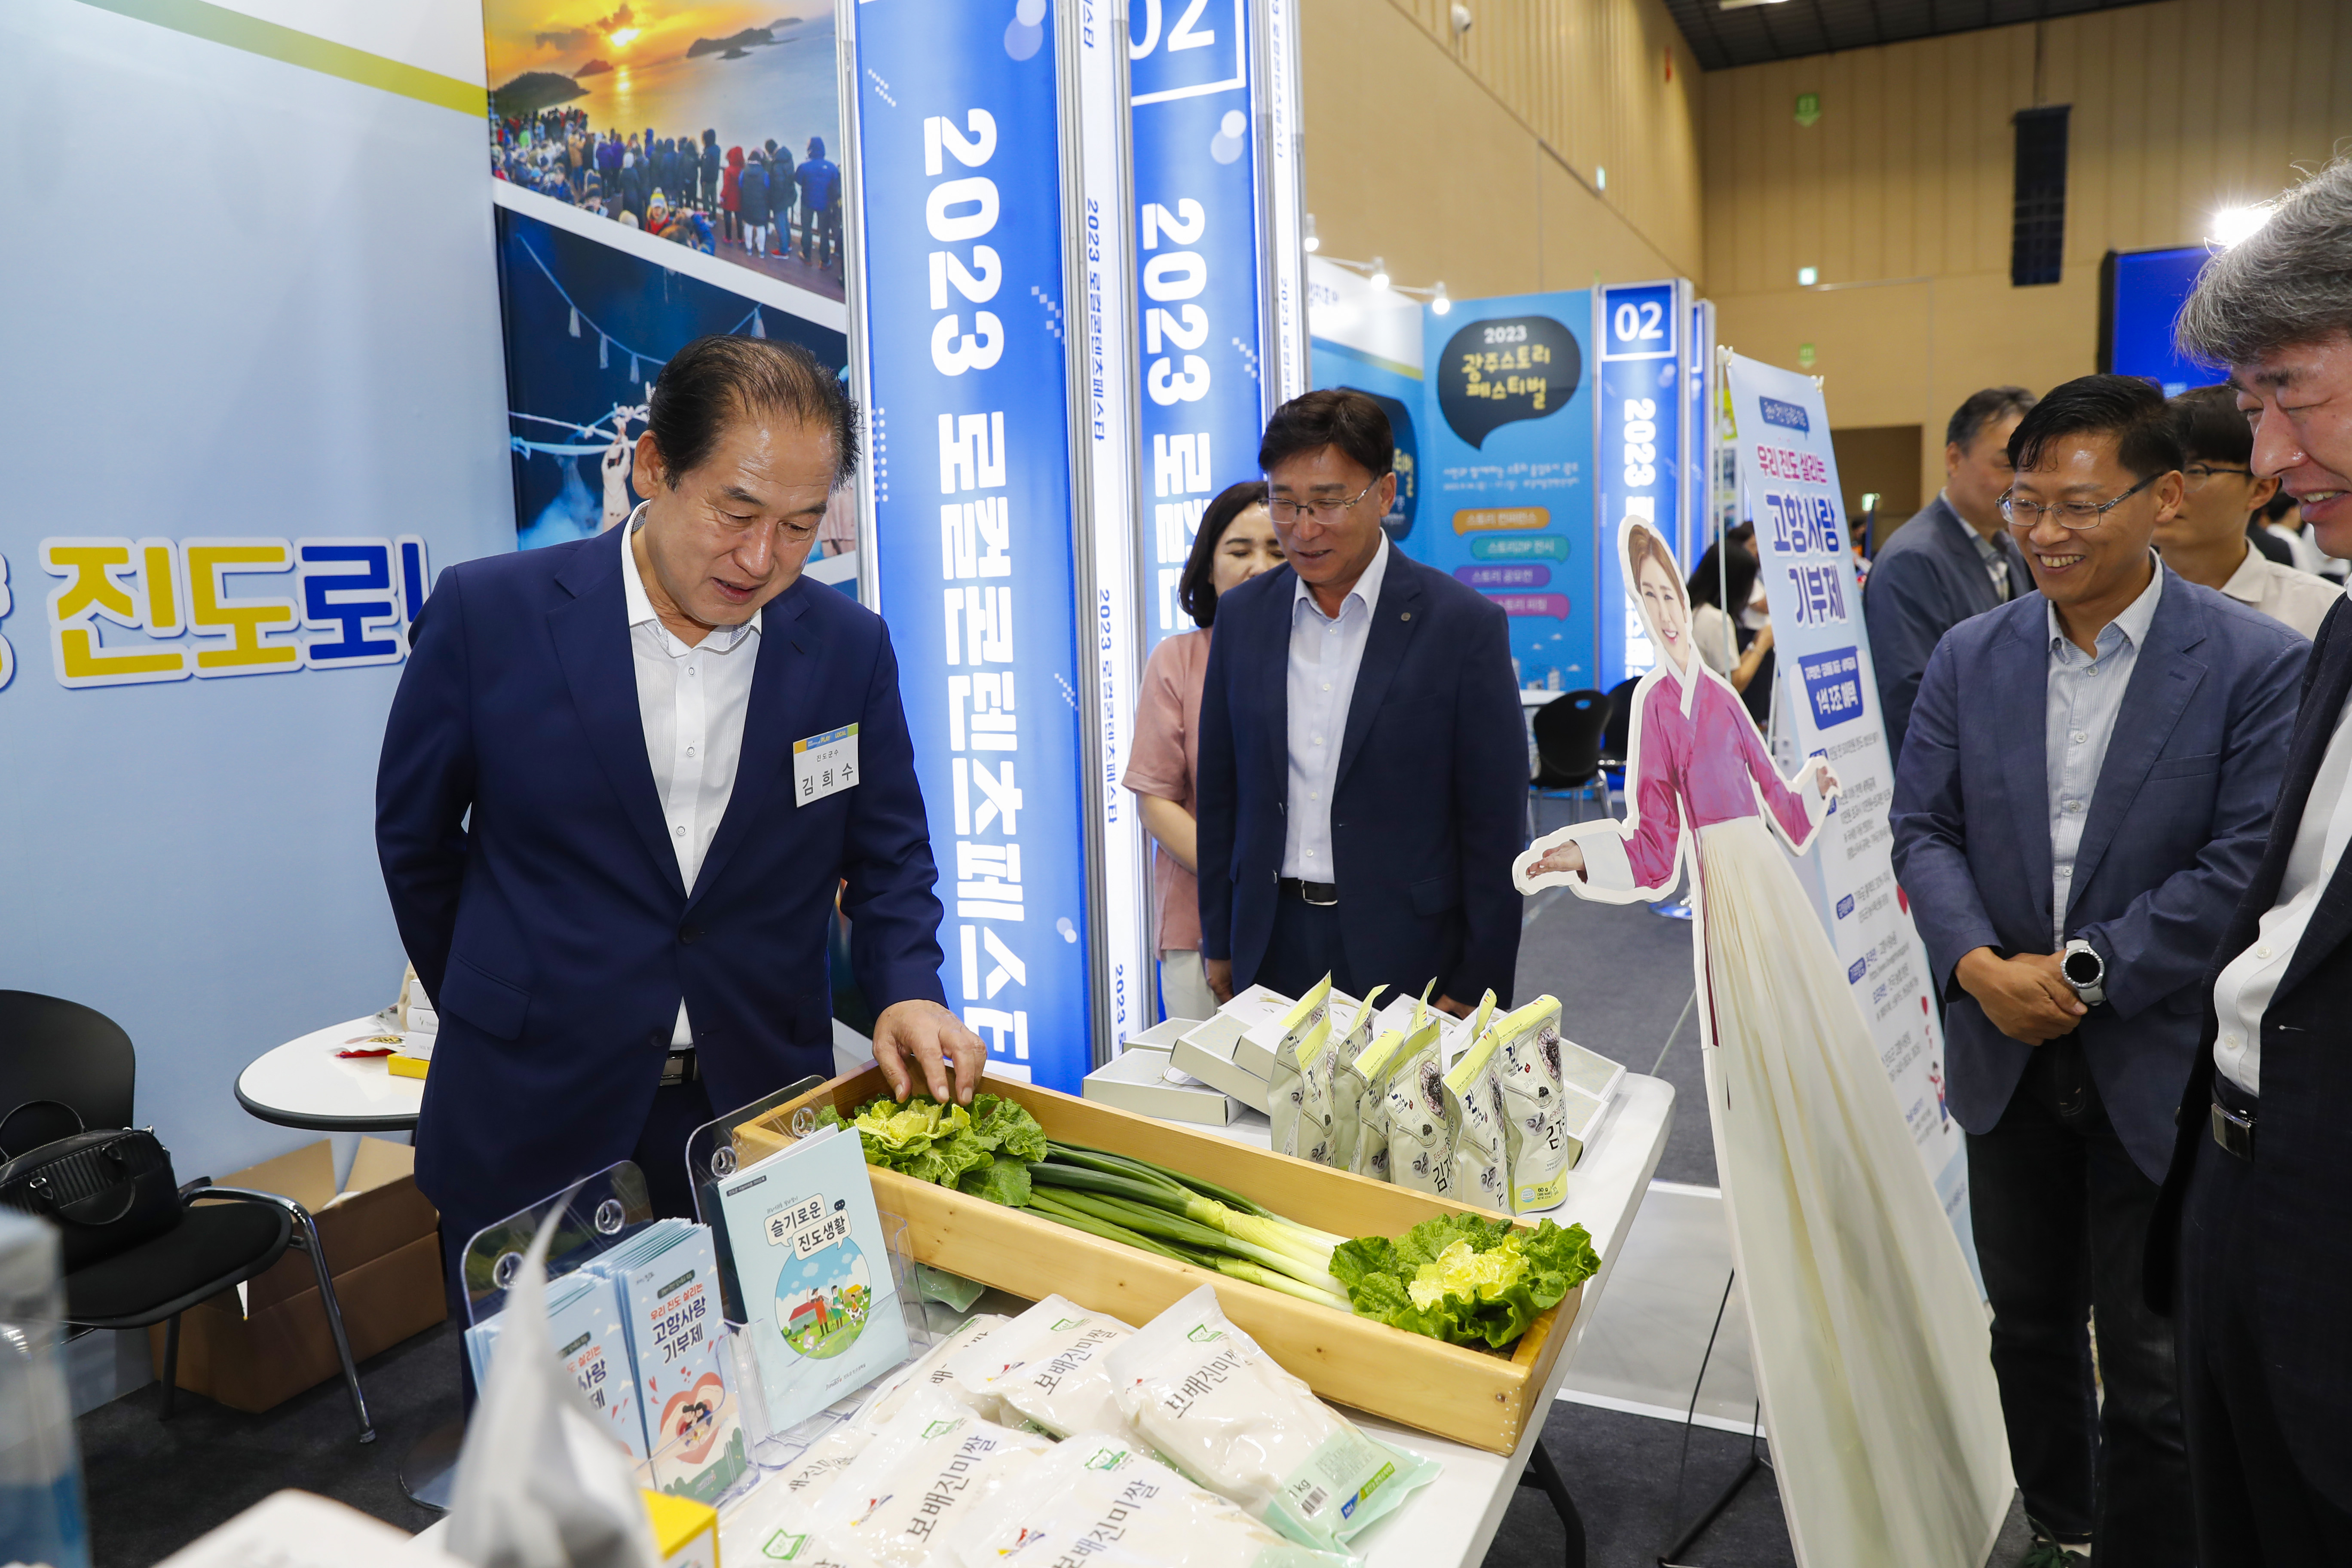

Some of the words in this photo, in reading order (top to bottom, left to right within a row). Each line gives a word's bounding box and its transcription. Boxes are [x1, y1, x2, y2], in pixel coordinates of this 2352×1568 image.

[923, 108, 1004, 377] 2023
[1087, 198, 1099, 263] 2023
[1142, 198, 1211, 406] 2023
[1615, 301, 1664, 342] 02
[1484, 325, 1527, 343] 2023
[1090, 270, 1105, 441] 로컬콘텐츠페스타
[1462, 344, 1550, 383] 광주스토리
[1466, 376, 1546, 410] 페스티벌
[1623, 398, 1656, 487] 2023
[1757, 446, 1780, 477] 우리
[1779, 450, 1801, 479] 진도
[1800, 452, 1827, 483] 살리는
[1766, 492, 1840, 554] 고향사랑
[40, 536, 430, 689] 진도로
[1789, 566, 1847, 625] 기부제
[1099, 589, 1112, 650] 2023
[835, 730, 846, 738] LOCAL
[1102, 660, 1118, 823] 로컬콘텐츠페스타
[816, 749, 839, 762] 진도군수
[802, 763, 854, 796] 김희수
[1116, 964, 1126, 1024] 2023
[1433, 1152, 1453, 1193] 김자
[771, 1201, 821, 1237] 슬기로운
[798, 1216, 846, 1252] 진도생활
[651, 1306, 666, 1320] 우리
[667, 1295, 682, 1311] 진도
[683, 1283, 703, 1302] 살리는
[652, 1295, 706, 1345] 고향사랑
[663, 1322, 704, 1364] 기부제
[1033, 1329, 1118, 1396] 보배진미쌀
[578, 1358, 606, 1391] 사랑
[825, 1377, 840, 1391] Jindo
[905, 1435, 997, 1543] 보배진미쌀
[1292, 1479, 1312, 1493] kg
